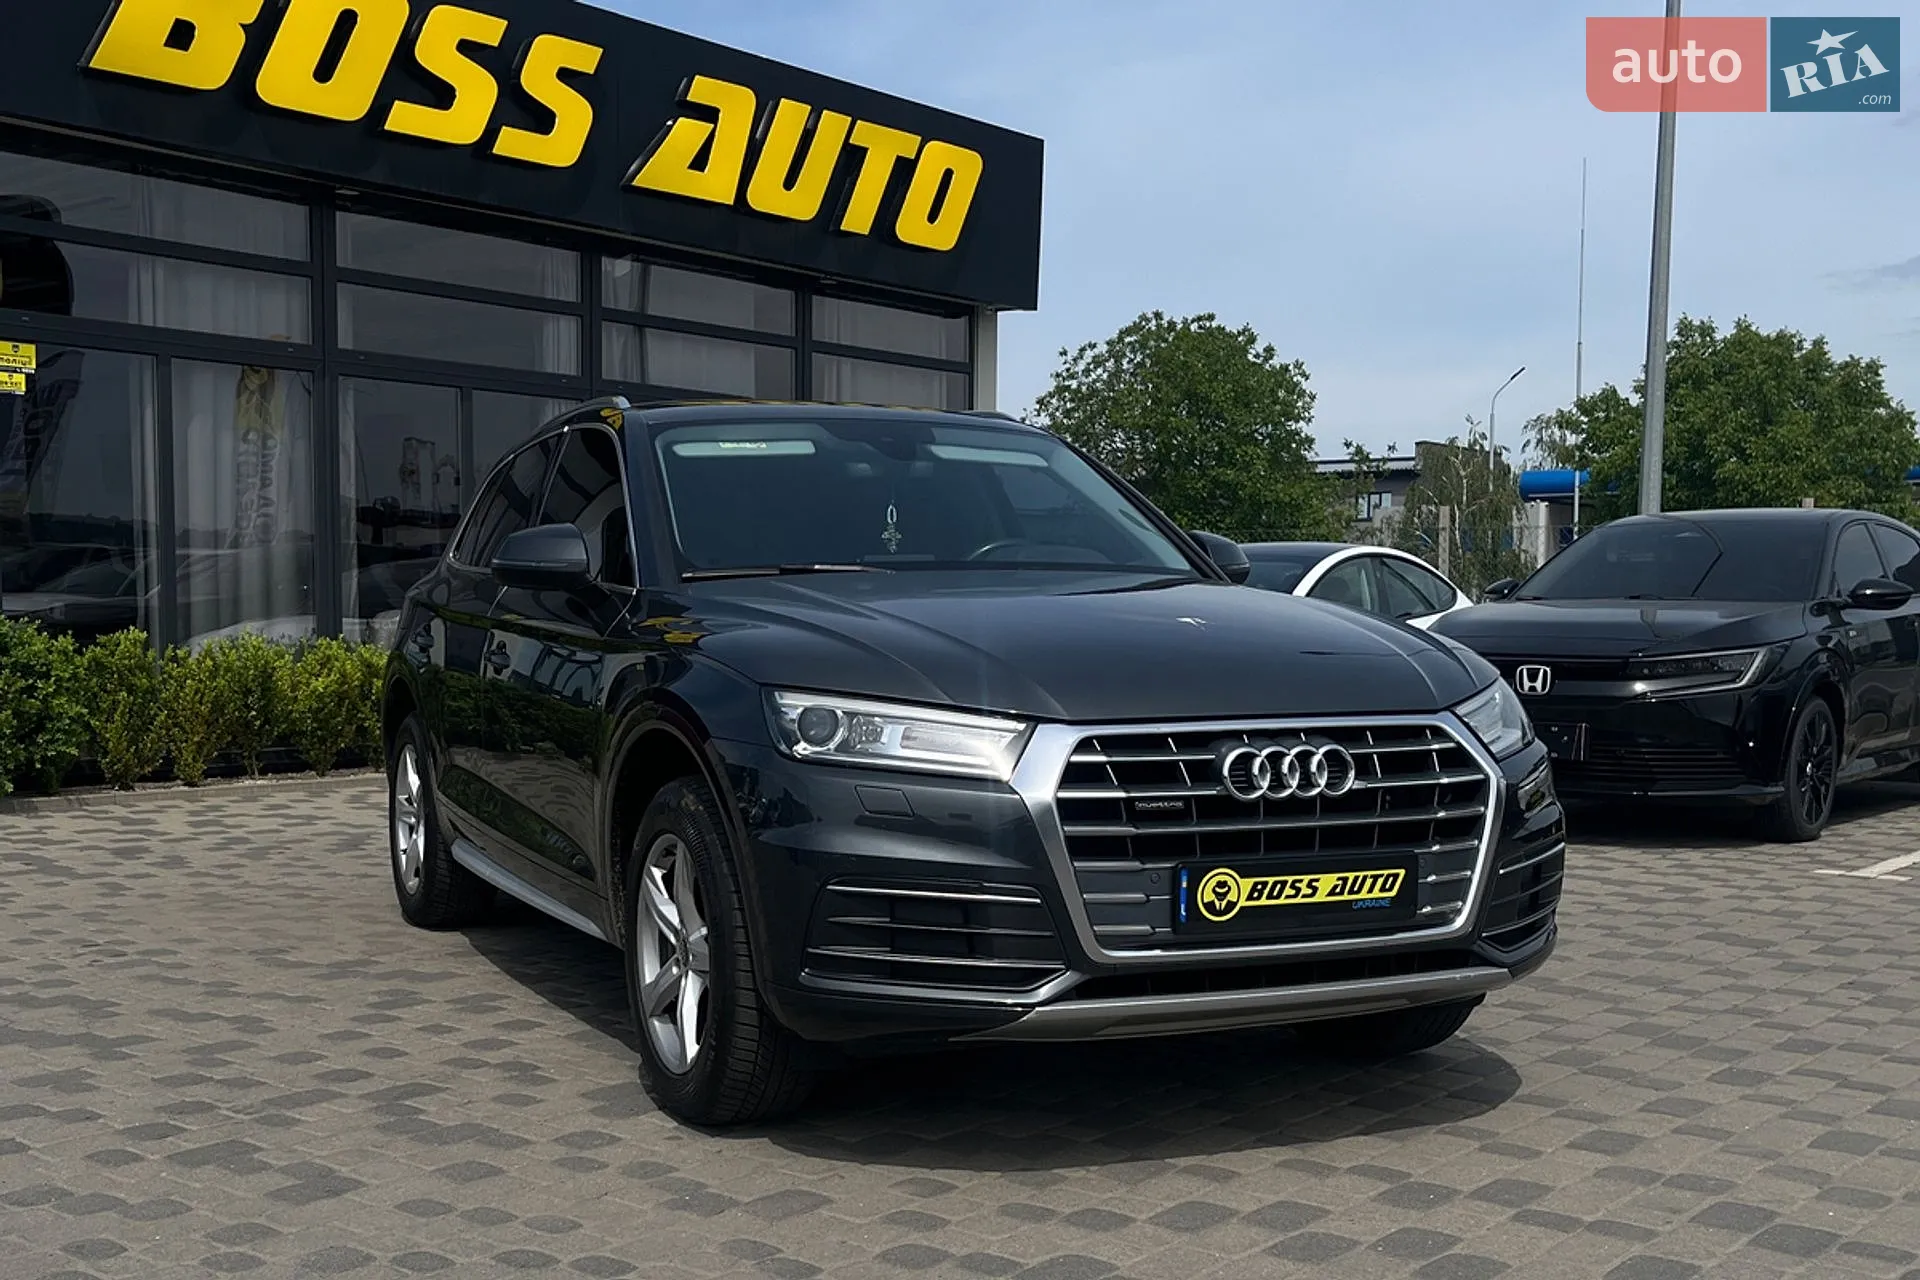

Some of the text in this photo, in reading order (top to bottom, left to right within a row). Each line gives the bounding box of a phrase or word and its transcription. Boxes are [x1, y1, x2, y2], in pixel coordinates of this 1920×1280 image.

[88, 0, 984, 252] BOSS AUTO
[1245, 872, 1400, 901] BOSS AUTO
[1352, 898, 1392, 909] UKRAINE
